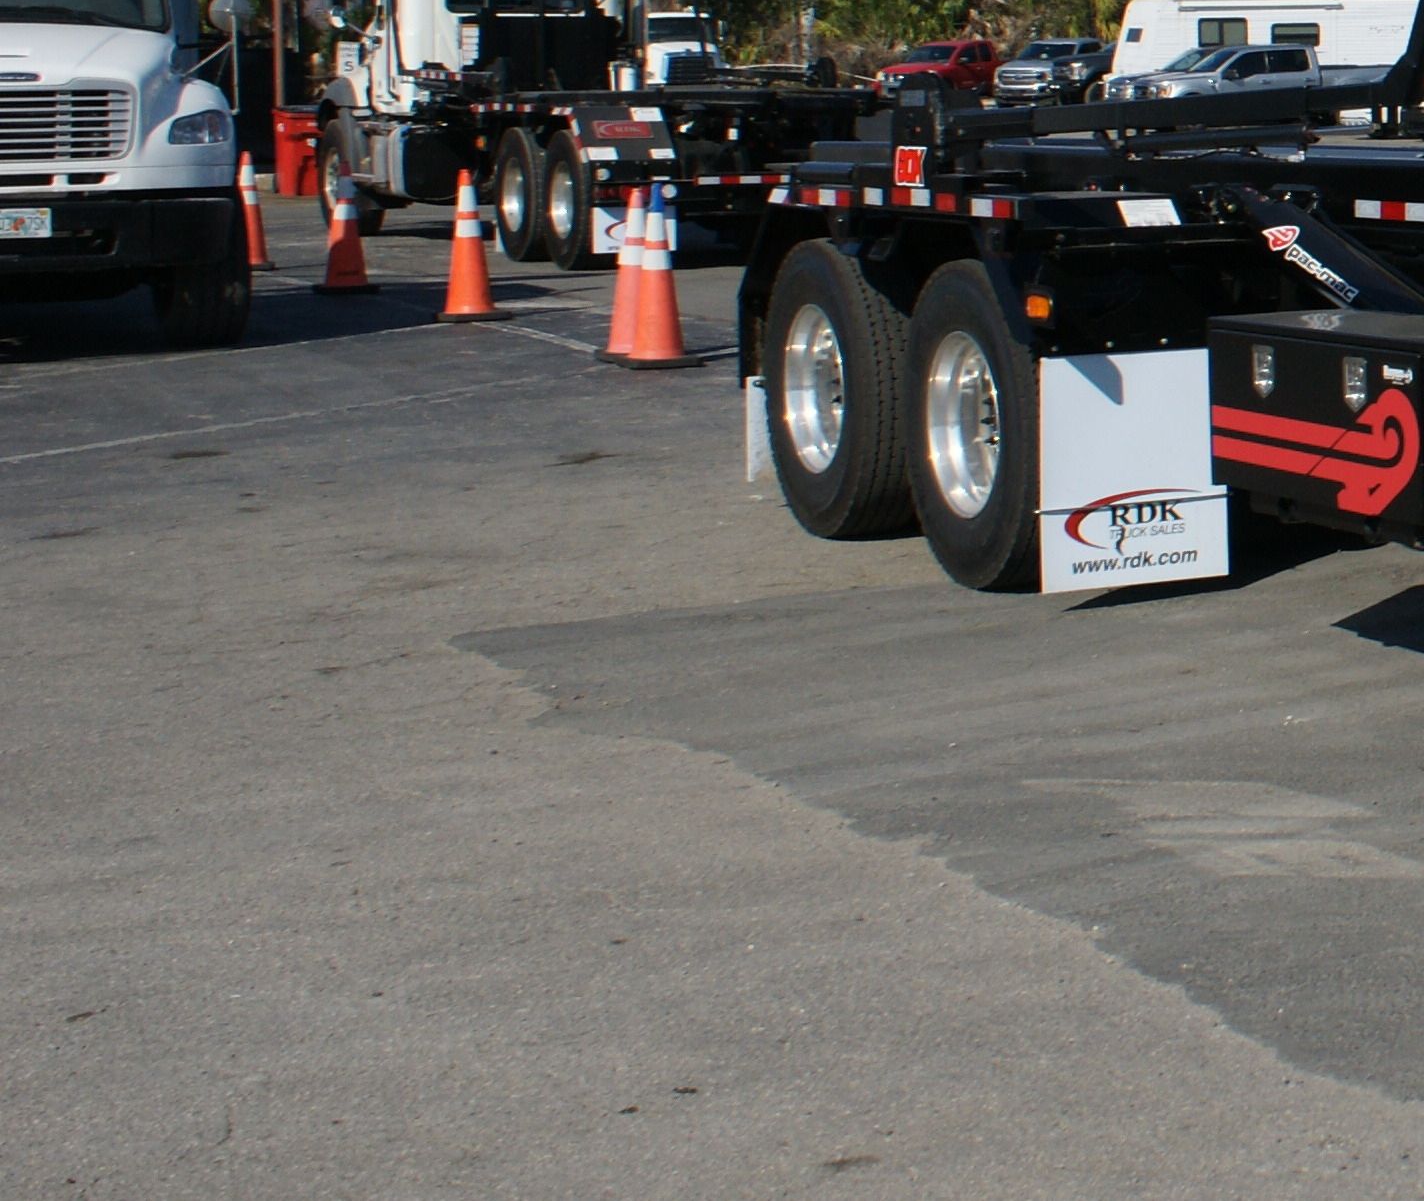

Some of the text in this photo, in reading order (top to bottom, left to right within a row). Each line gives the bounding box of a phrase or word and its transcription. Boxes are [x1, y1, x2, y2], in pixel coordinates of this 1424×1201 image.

[1285, 245, 1358, 302] pac-mac
[1108, 500, 1184, 527] RDK
[1151, 522, 1186, 537] SALES
[1072, 549, 1198, 574] www.rdk.com
